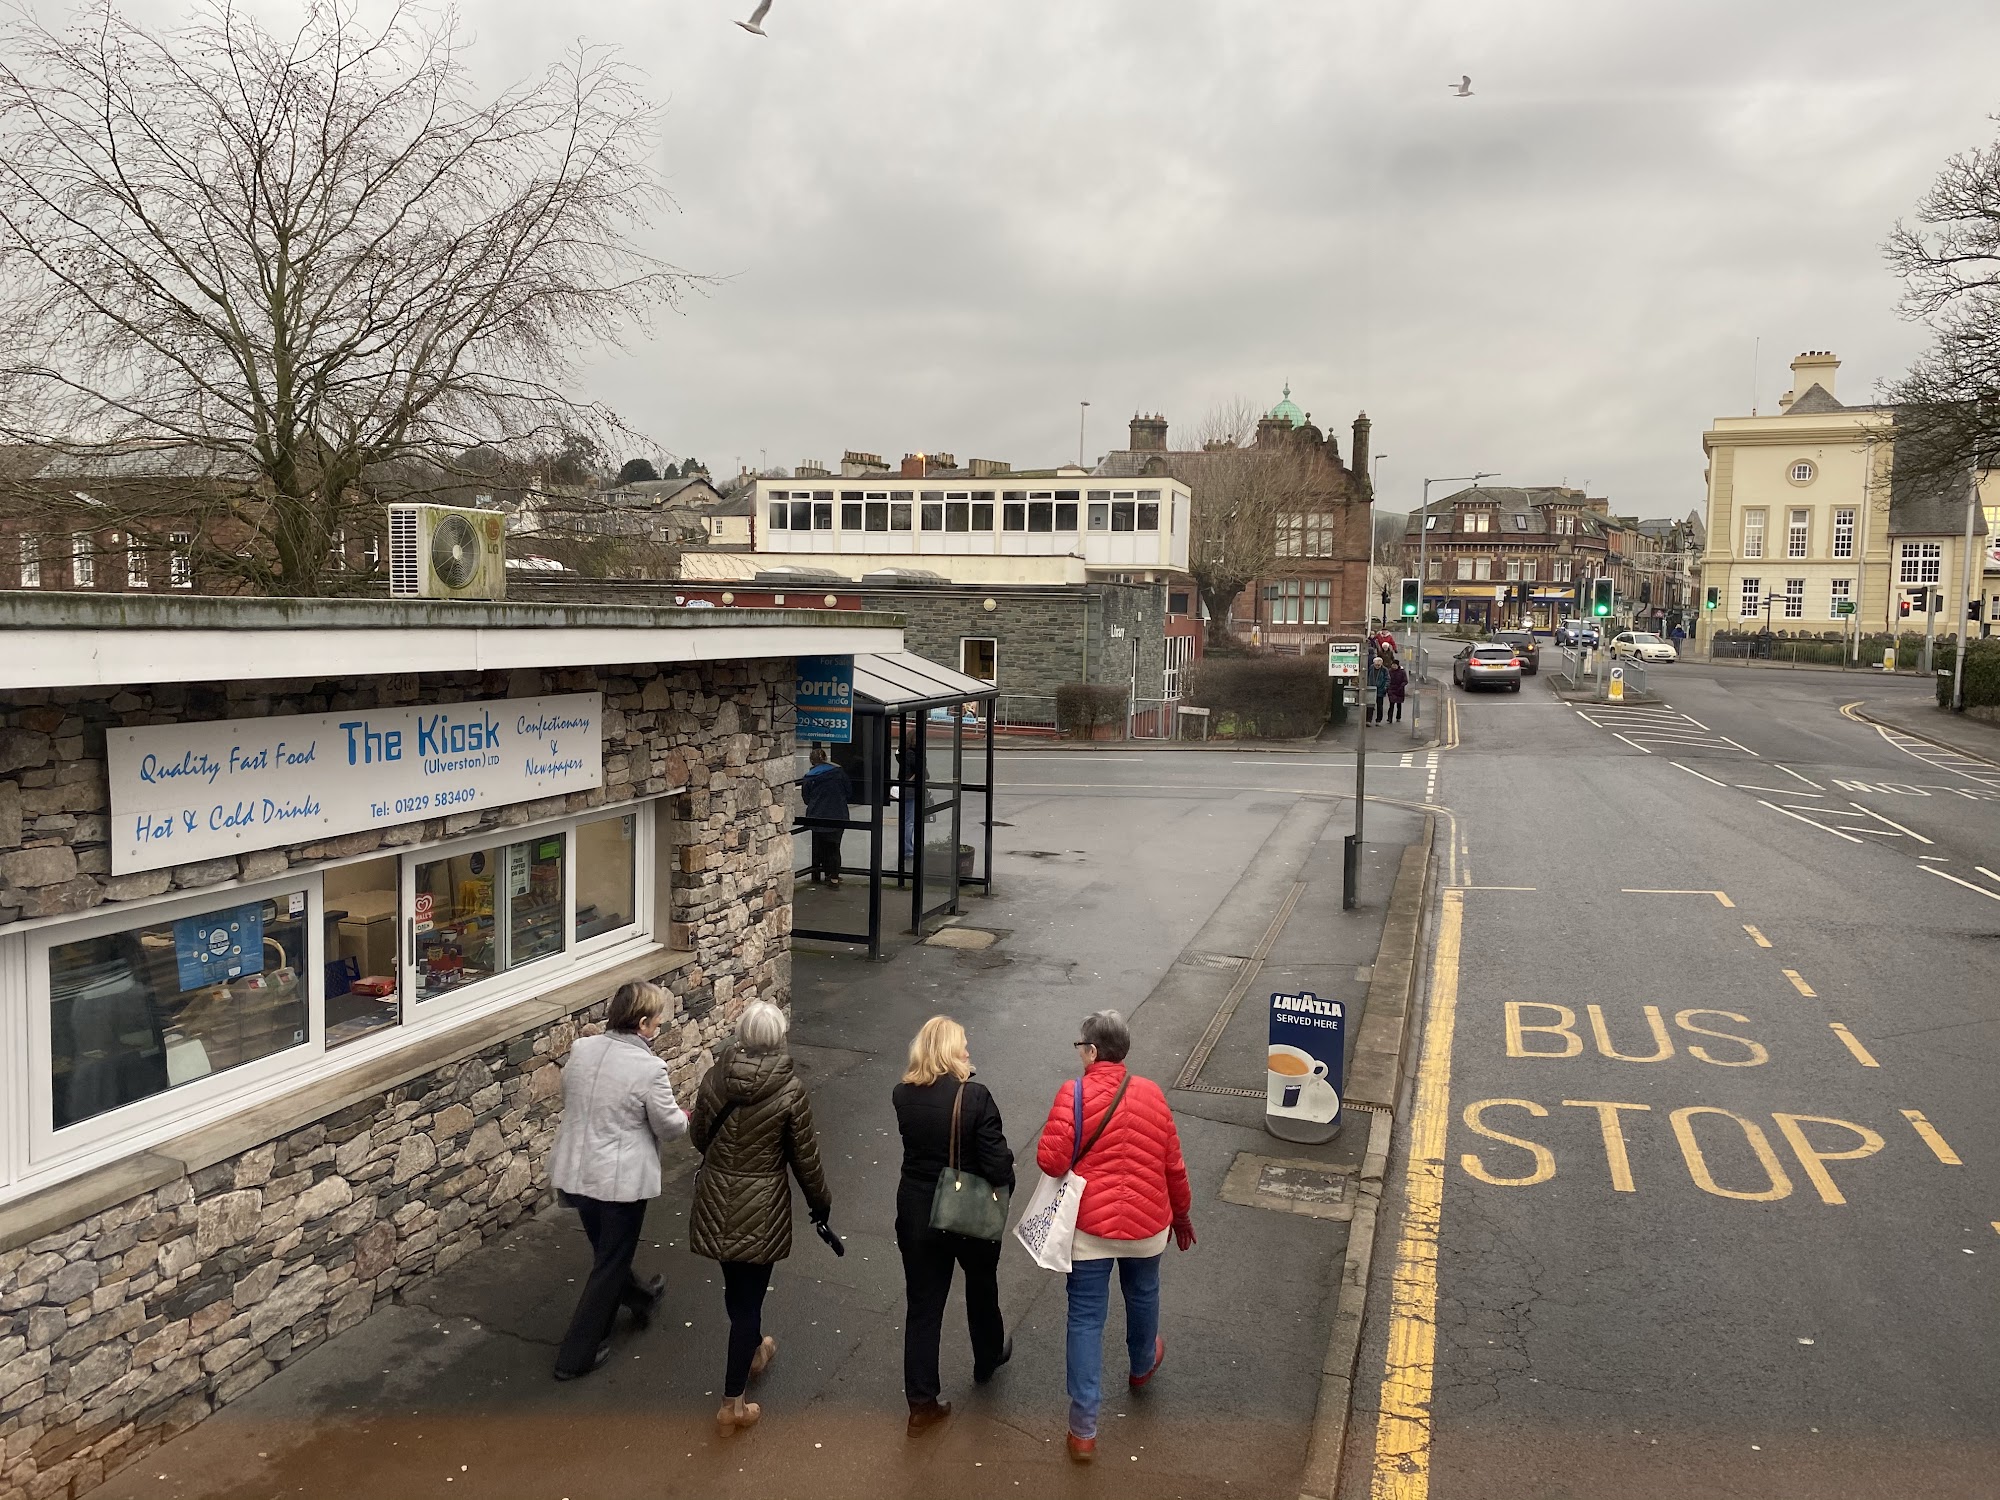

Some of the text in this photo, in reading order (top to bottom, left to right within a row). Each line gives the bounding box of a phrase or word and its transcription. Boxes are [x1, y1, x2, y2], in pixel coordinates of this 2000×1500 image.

[487, 543, 499, 555] LG
[338, 710, 500, 766] The Kiosk
[516, 714, 591, 740] Confectionary
[550, 739, 559, 756] &
[140, 740, 316, 785] Quality Fast Food
[423, 752, 500, 776] (Ulverston) LTD
[524, 756, 584, 779] Newspapers
[370, 788, 476, 818] Tel: 01229 583409
[136, 794, 321, 843] Hot & Cold Drinks
[1273, 994, 1343, 1018] LAVAZZA
[1276, 1013, 1338, 1030] SERVED HERE
[1504, 1000, 1770, 1067] BUS
[1460, 1097, 1886, 1205] STOP
